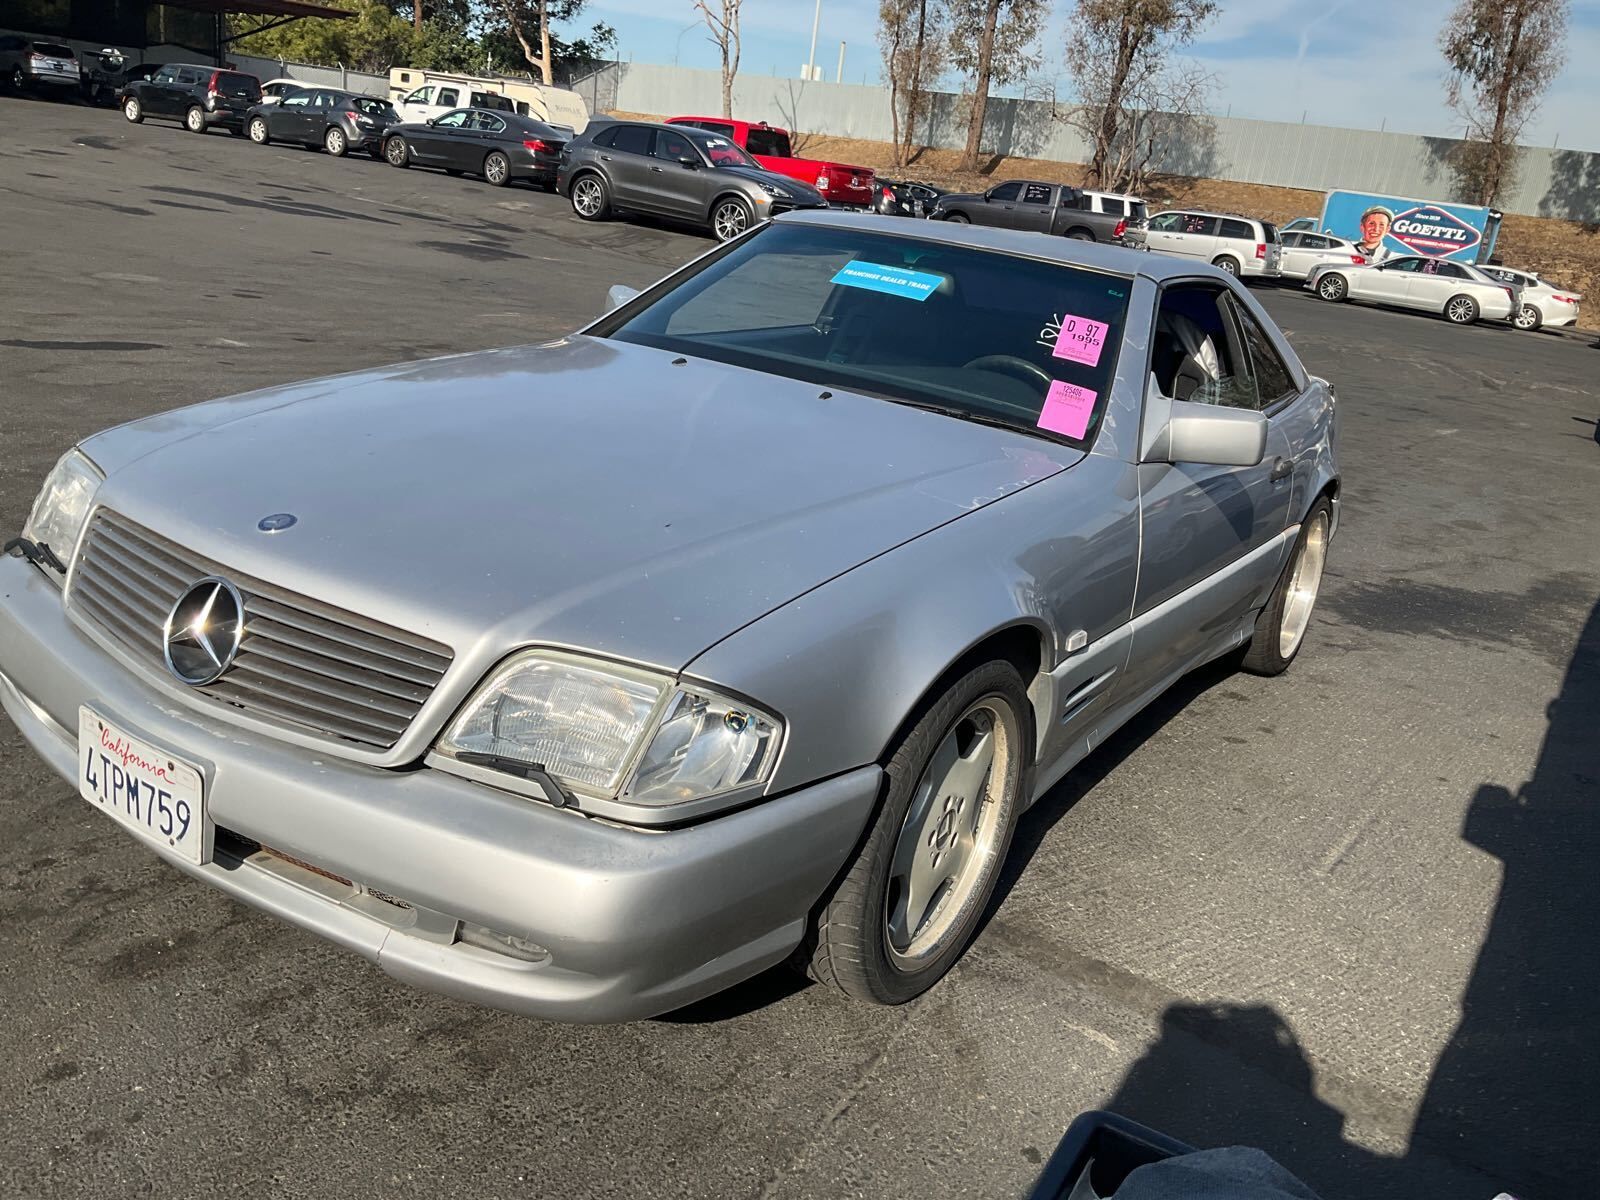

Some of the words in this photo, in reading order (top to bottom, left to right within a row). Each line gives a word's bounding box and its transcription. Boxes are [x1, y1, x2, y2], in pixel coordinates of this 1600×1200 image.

[1393, 219, 1467, 241] GOETTL
[843, 269, 881, 281] FRANCHISE
[880, 275, 908, 286] DEALER
[907, 281, 932, 291] TRADE
[1071, 333, 1100, 346] 1995
[1085, 324, 1100, 338] 97
[101, 728, 176, 785] California
[86, 746, 191, 841] 4TPM759
